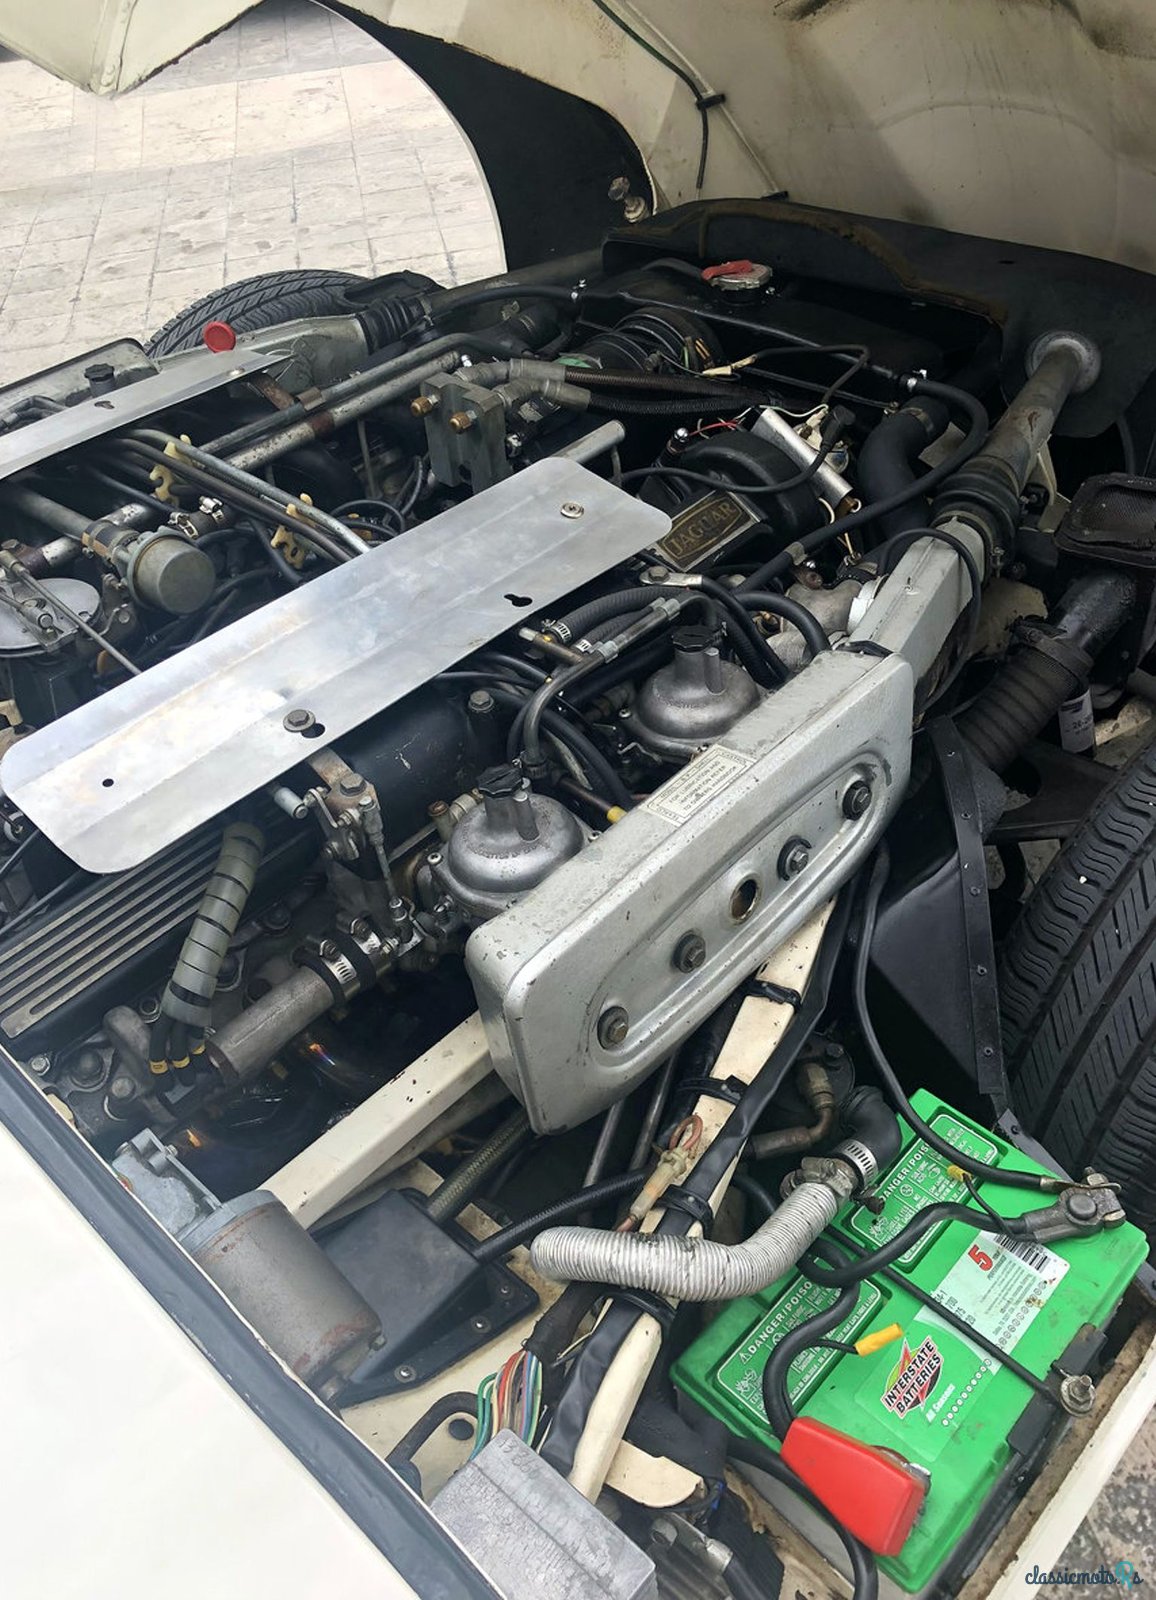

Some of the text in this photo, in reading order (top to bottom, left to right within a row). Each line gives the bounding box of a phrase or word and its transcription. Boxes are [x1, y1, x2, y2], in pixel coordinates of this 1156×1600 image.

[668, 502, 734, 555] JAGUAR
[880, 1143, 929, 1202] DANGER/POIS
[968, 1244, 994, 1271] 5
[748, 1281, 812, 1354] DANGER/POISO
[885, 1341, 935, 1406] INTERSTATE
[897, 1354, 941, 1414] BATTERIES
